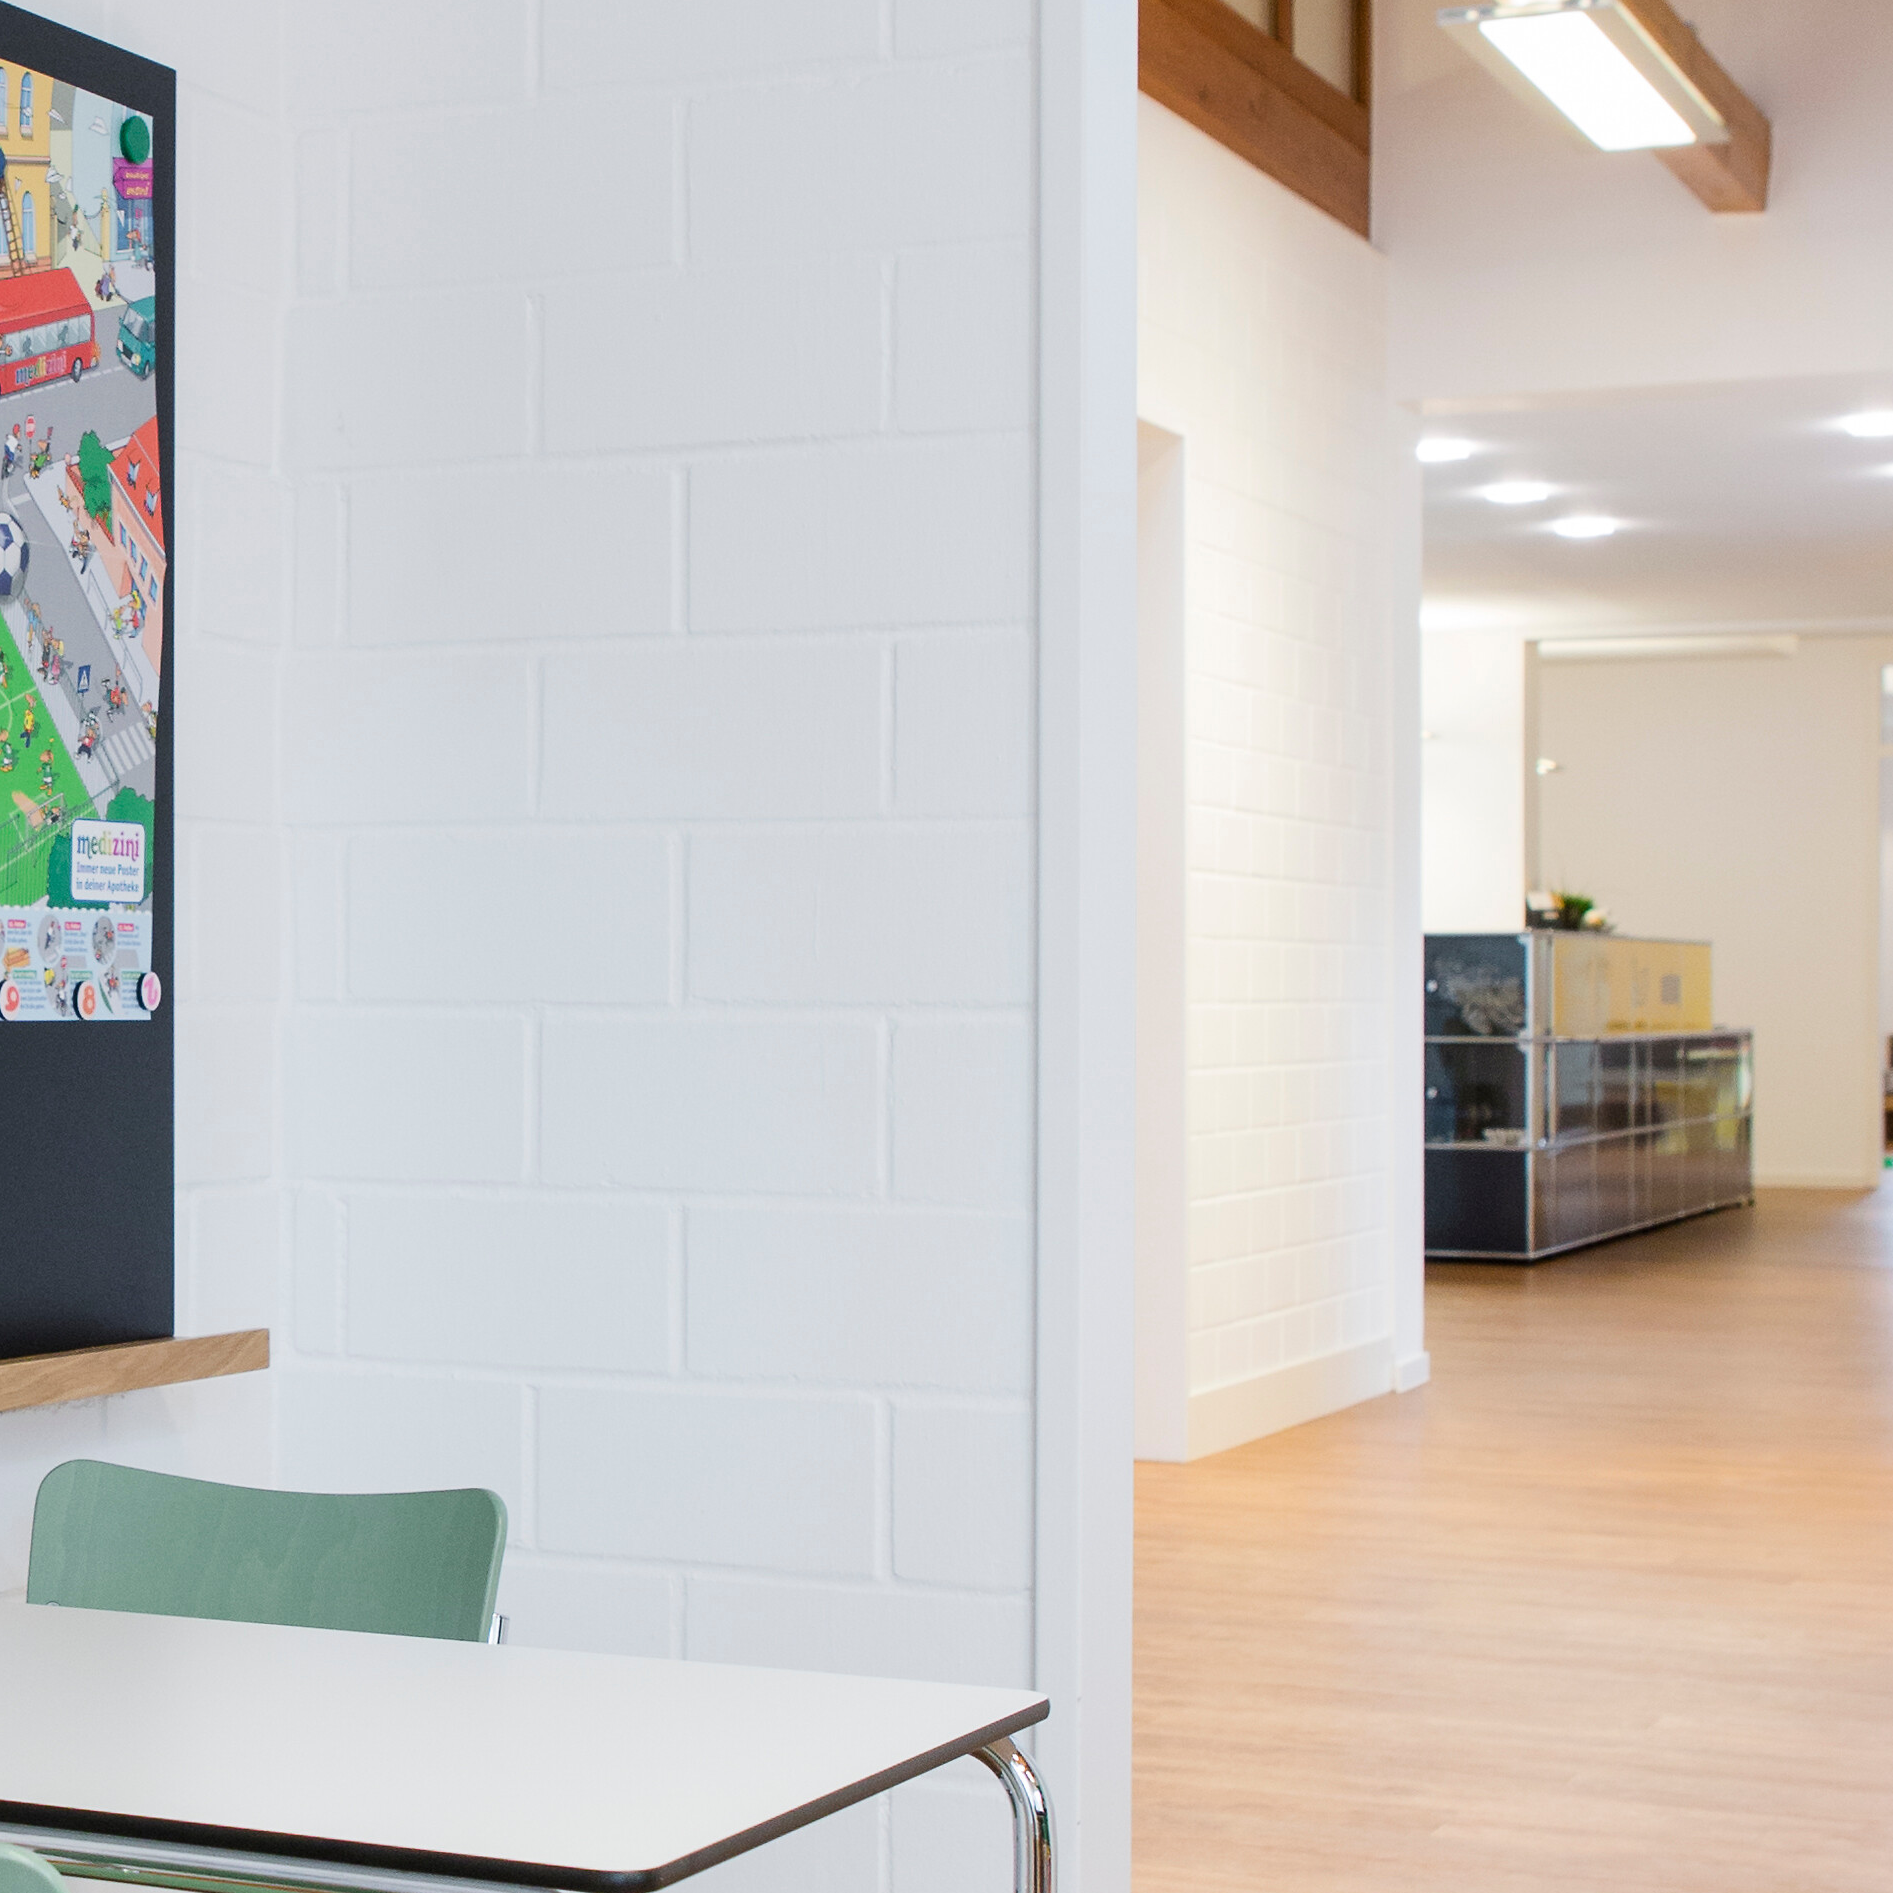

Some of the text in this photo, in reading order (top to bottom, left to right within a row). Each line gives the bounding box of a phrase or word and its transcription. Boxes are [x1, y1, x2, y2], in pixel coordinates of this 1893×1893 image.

[77, 831, 139, 861] medizini
[118, 864, 139, 875] Poster
[82, 985, 95, 1015] 8
